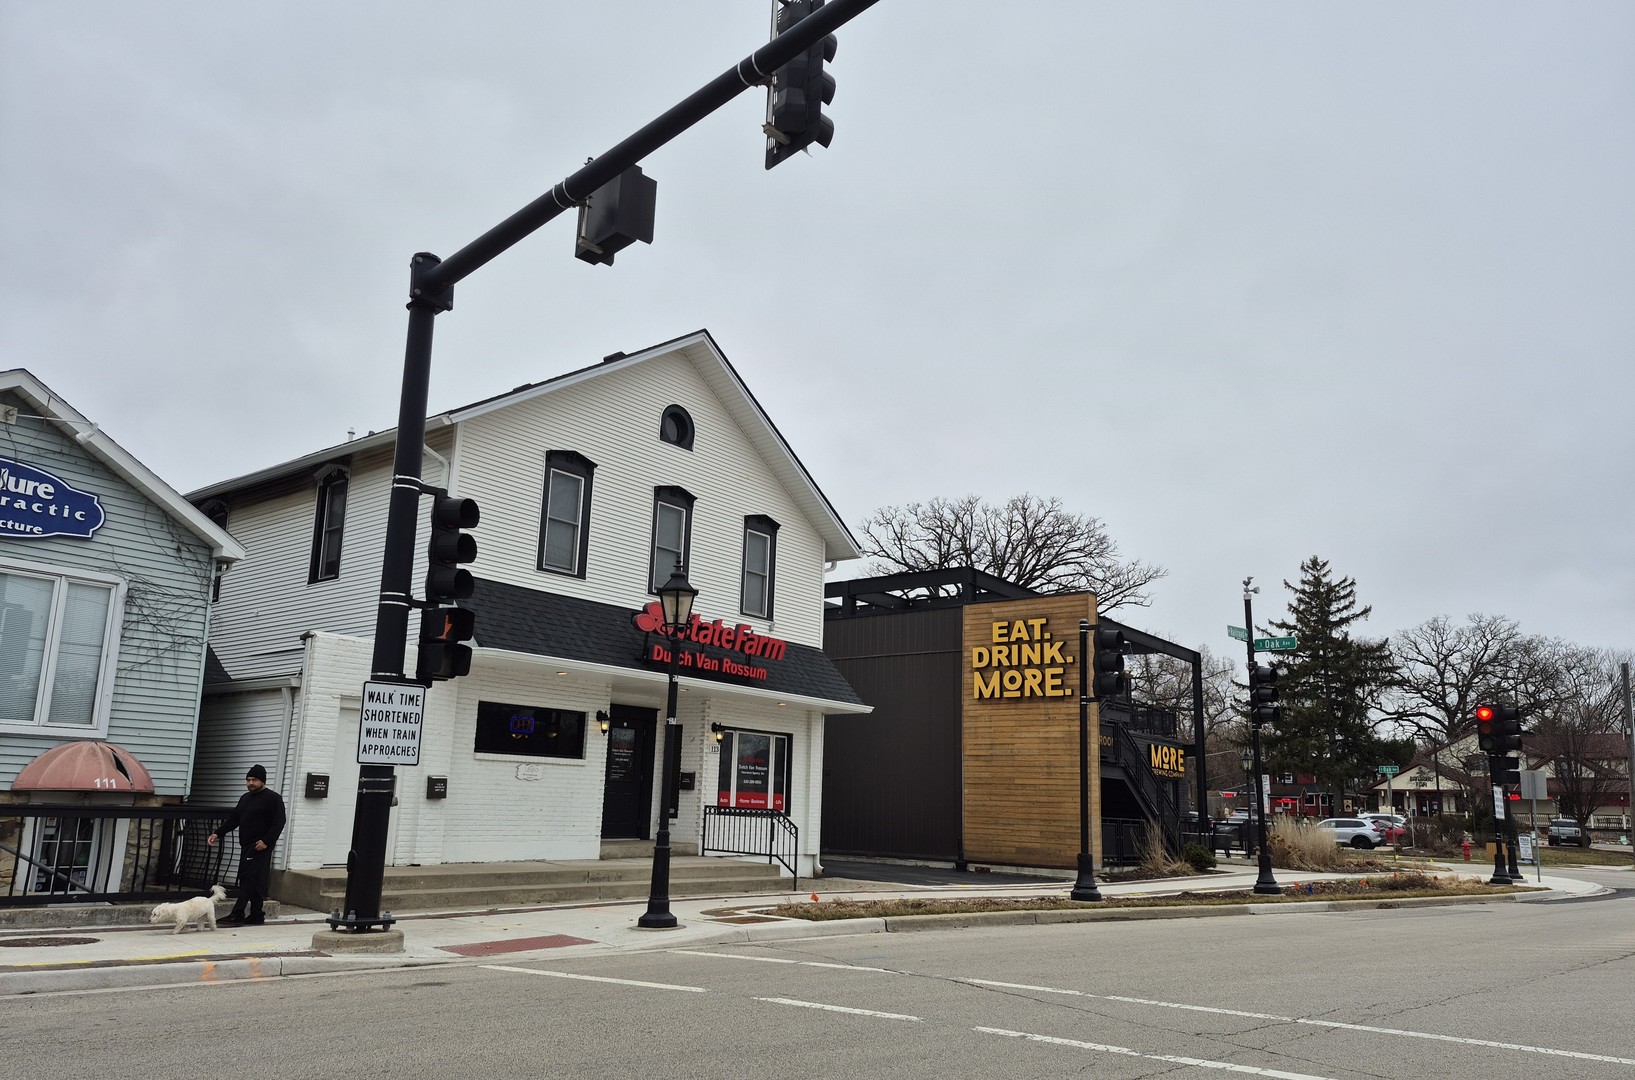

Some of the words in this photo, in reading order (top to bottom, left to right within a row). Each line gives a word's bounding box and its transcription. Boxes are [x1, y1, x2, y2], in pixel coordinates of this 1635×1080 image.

[0, 468, 55, 500] ure
[0, 496, 86, 521] ractic
[992, 618, 1051, 643] EAT.
[1264, 639, 1280, 649] Oak
[652, 645, 692, 666] Duch
[696, 652, 719, 671] Van
[722, 658, 768, 680] Rossum
[972, 641, 1074, 668] DRINK.
[973, 667, 1072, 699] MORE.
[368, 691, 394, 705] WALK
[400, 693, 421, 707] TIME
[364, 709, 421, 724] SHORTENED
[365, 727, 389, 739] WHEN
[393, 729, 416, 740] TRAIN
[1100, 735, 1114, 747] ROO
[361, 744, 417, 757] APPROACHES
[1151, 743, 1185, 772] MORE
[94, 777, 117, 789] 111
